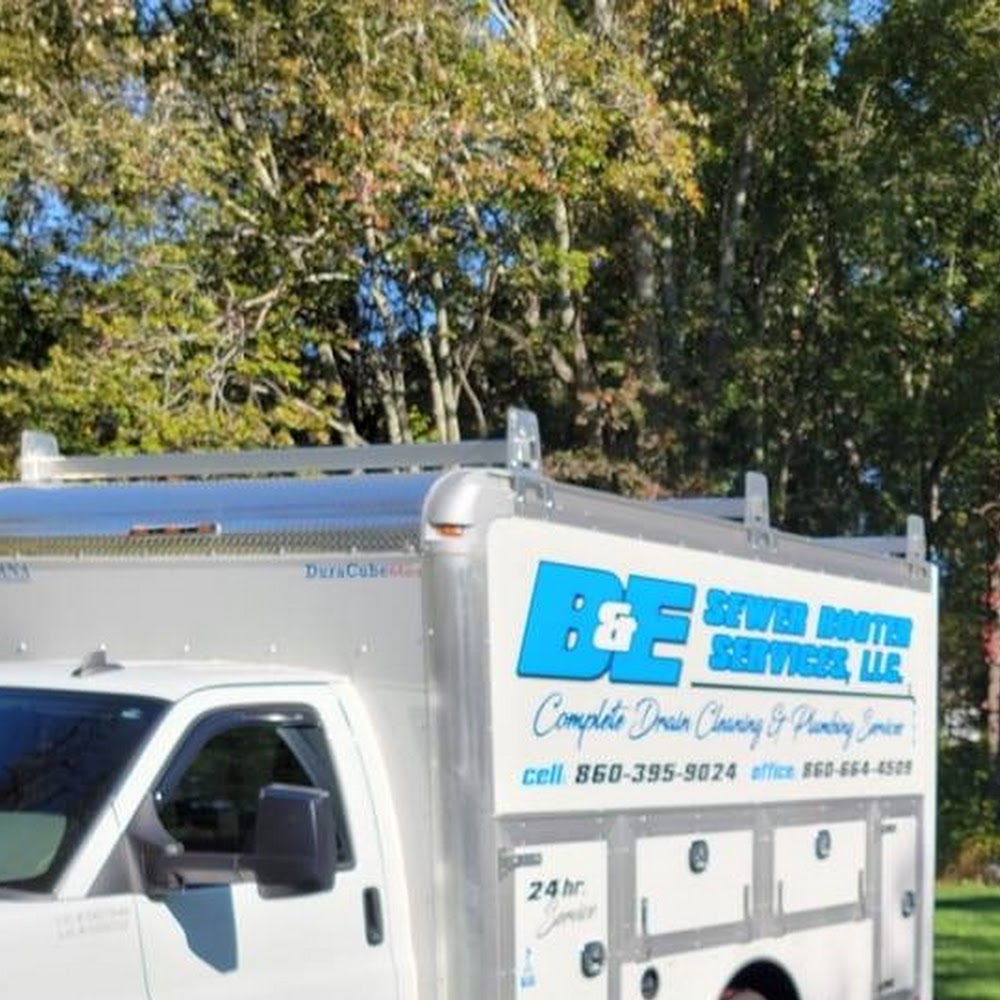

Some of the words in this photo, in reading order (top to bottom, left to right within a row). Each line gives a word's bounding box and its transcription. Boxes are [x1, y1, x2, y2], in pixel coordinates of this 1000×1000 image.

[516, 560, 697, 686] B&E
[703, 588, 809, 637] SEWER
[816, 605, 914, 648] ROOTER
[708, 634, 852, 684] SERVICES,
[532, 692, 629, 751] Complete
[629, 696, 690, 741] Drain
[694, 700, 763, 751] Cleaning
[522, 763, 564, 786] cell
[575, 761, 737, 785] 860-395-9024
[751, 761, 794, 780] office
[527, 879, 559, 901] 24
